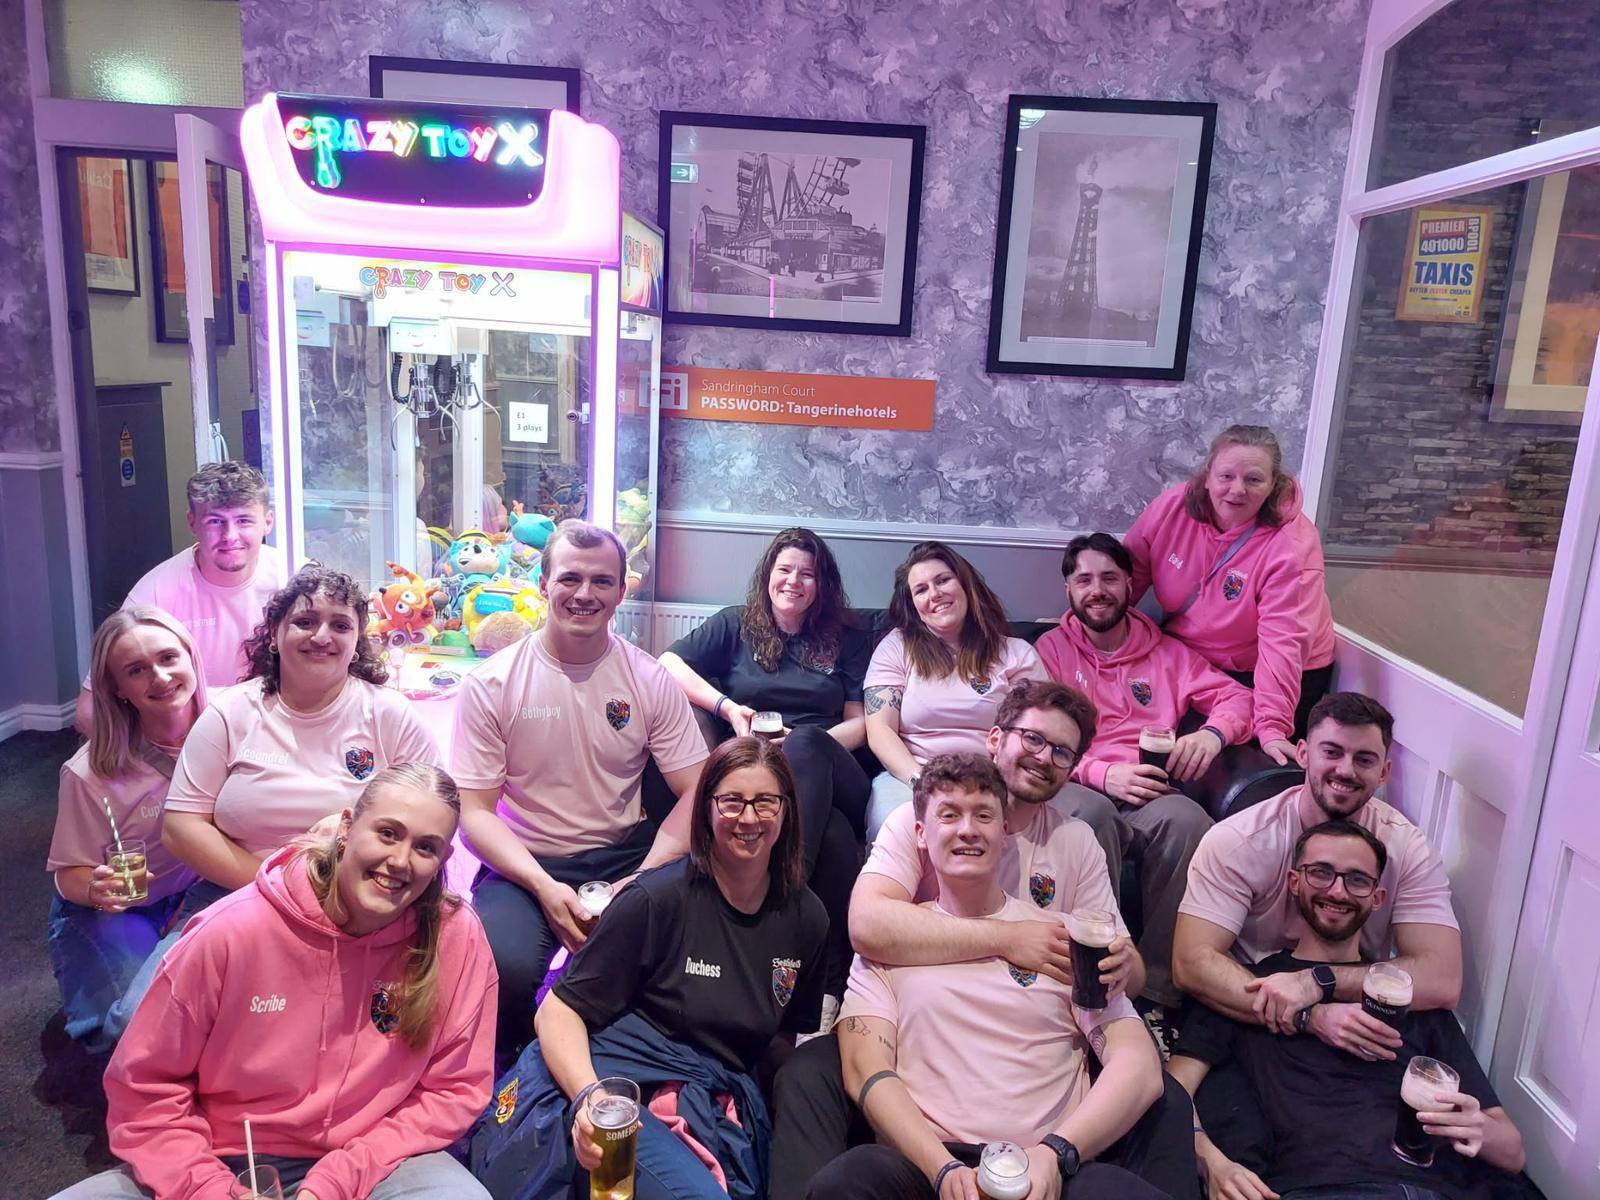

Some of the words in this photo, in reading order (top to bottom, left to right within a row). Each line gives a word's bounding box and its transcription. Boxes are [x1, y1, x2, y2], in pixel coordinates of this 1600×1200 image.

[285, 115, 420, 189] CRAZY
[420, 123, 498, 162] TOY
[497, 120, 545, 167] X
[1421, 220, 1465, 234] PREMIER
[1421, 237, 1465, 253] 401000
[359, 266, 433, 299] CRAZY
[438, 271, 486, 294] TOY
[489, 271, 517, 297] X
[1414, 261, 1474, 286] TAXIS
[701, 378, 779, 396] Sandringham
[782, 384, 816, 398] Court
[700, 396, 784, 414] PASSWORD:
[786, 401, 897, 419] Tangerinehotels
[523, 424, 542, 432] plays
[685, 956, 721, 978] Duchess
[249, 993, 287, 1014] Scribe
